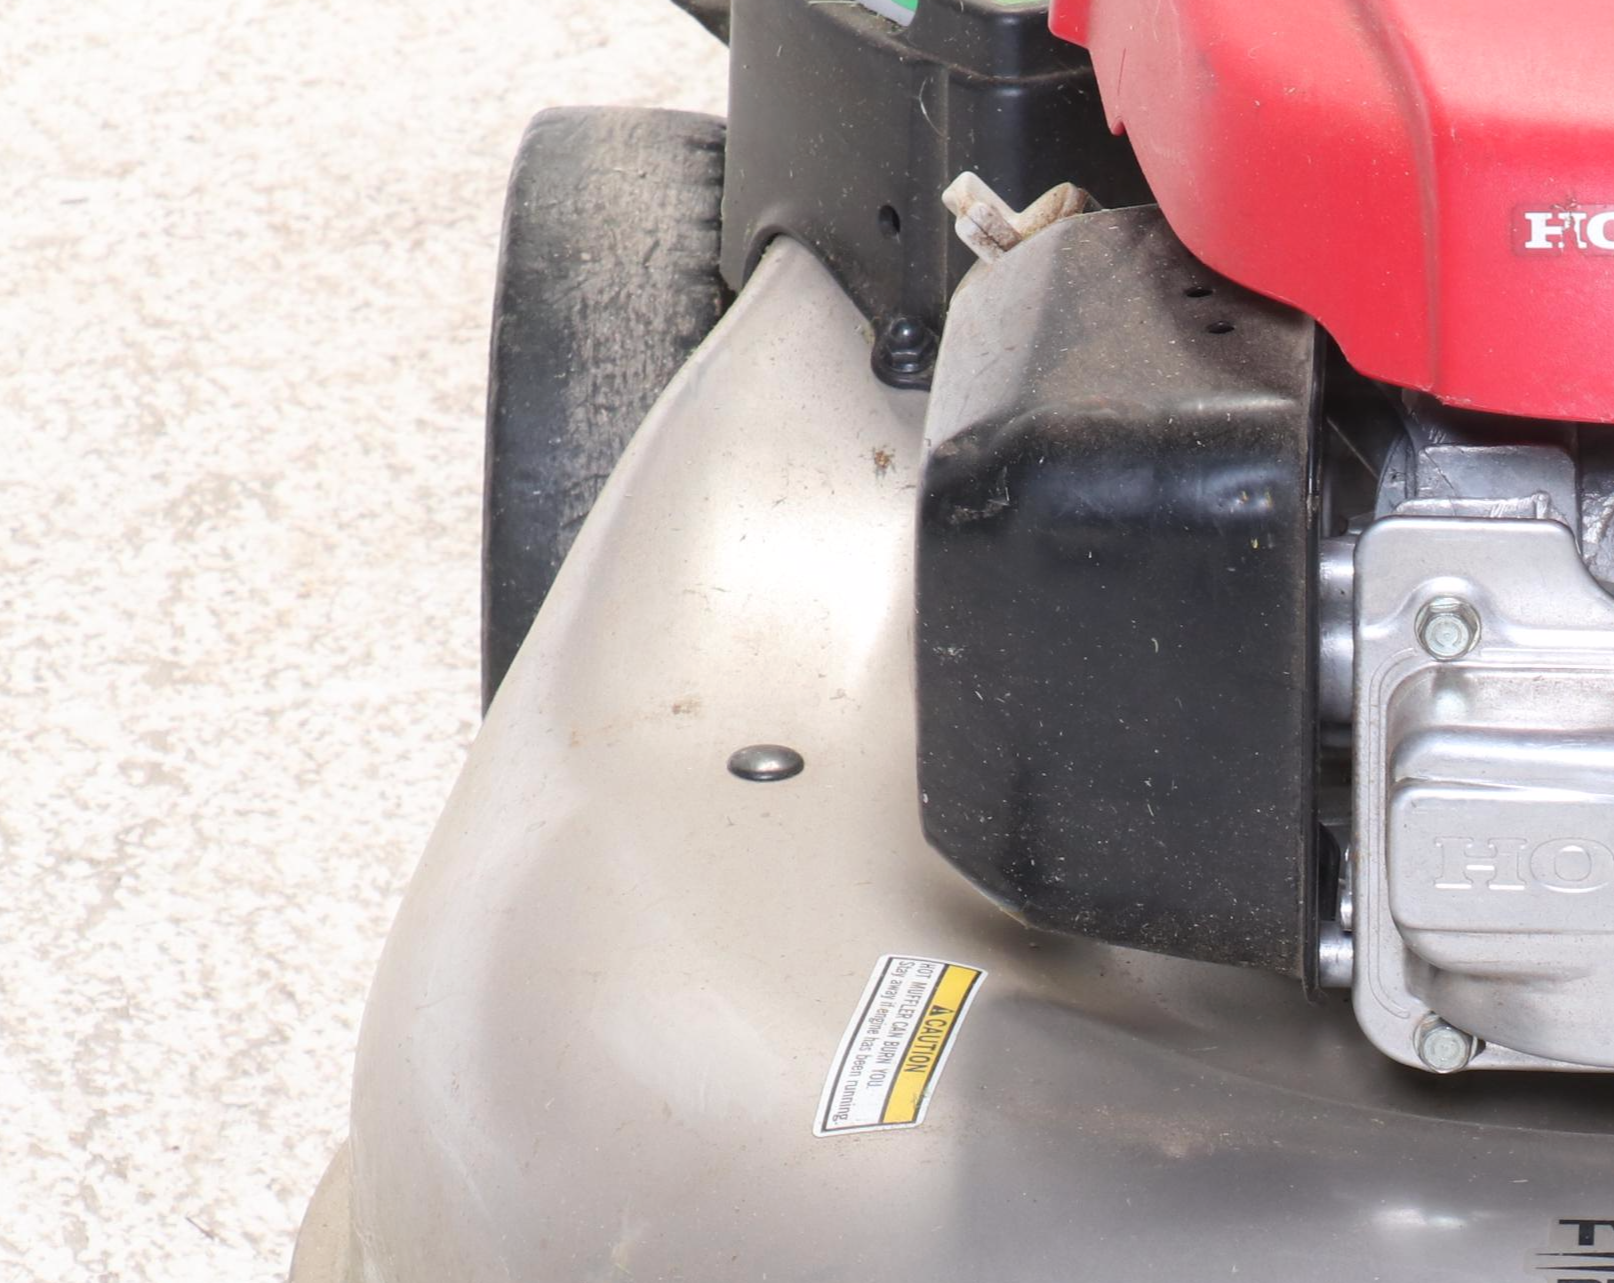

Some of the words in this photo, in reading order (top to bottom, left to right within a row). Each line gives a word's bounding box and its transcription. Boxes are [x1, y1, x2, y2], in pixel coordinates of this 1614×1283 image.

[895, 961, 915, 977] Stay
[916, 962, 936, 979] HOT
[880, 980, 903, 1002] away
[901, 982, 927, 1018] MUFFLER
[867, 1008, 889, 1035] engine
[892, 1021, 909, 1039] CAN
[860, 1034, 879, 1052] has
[875, 1041, 899, 1064] BURN
[904, 1019, 946, 1073] CAUTION
[851, 1054, 871, 1077] been
[832, 1079, 857, 1125] running.
